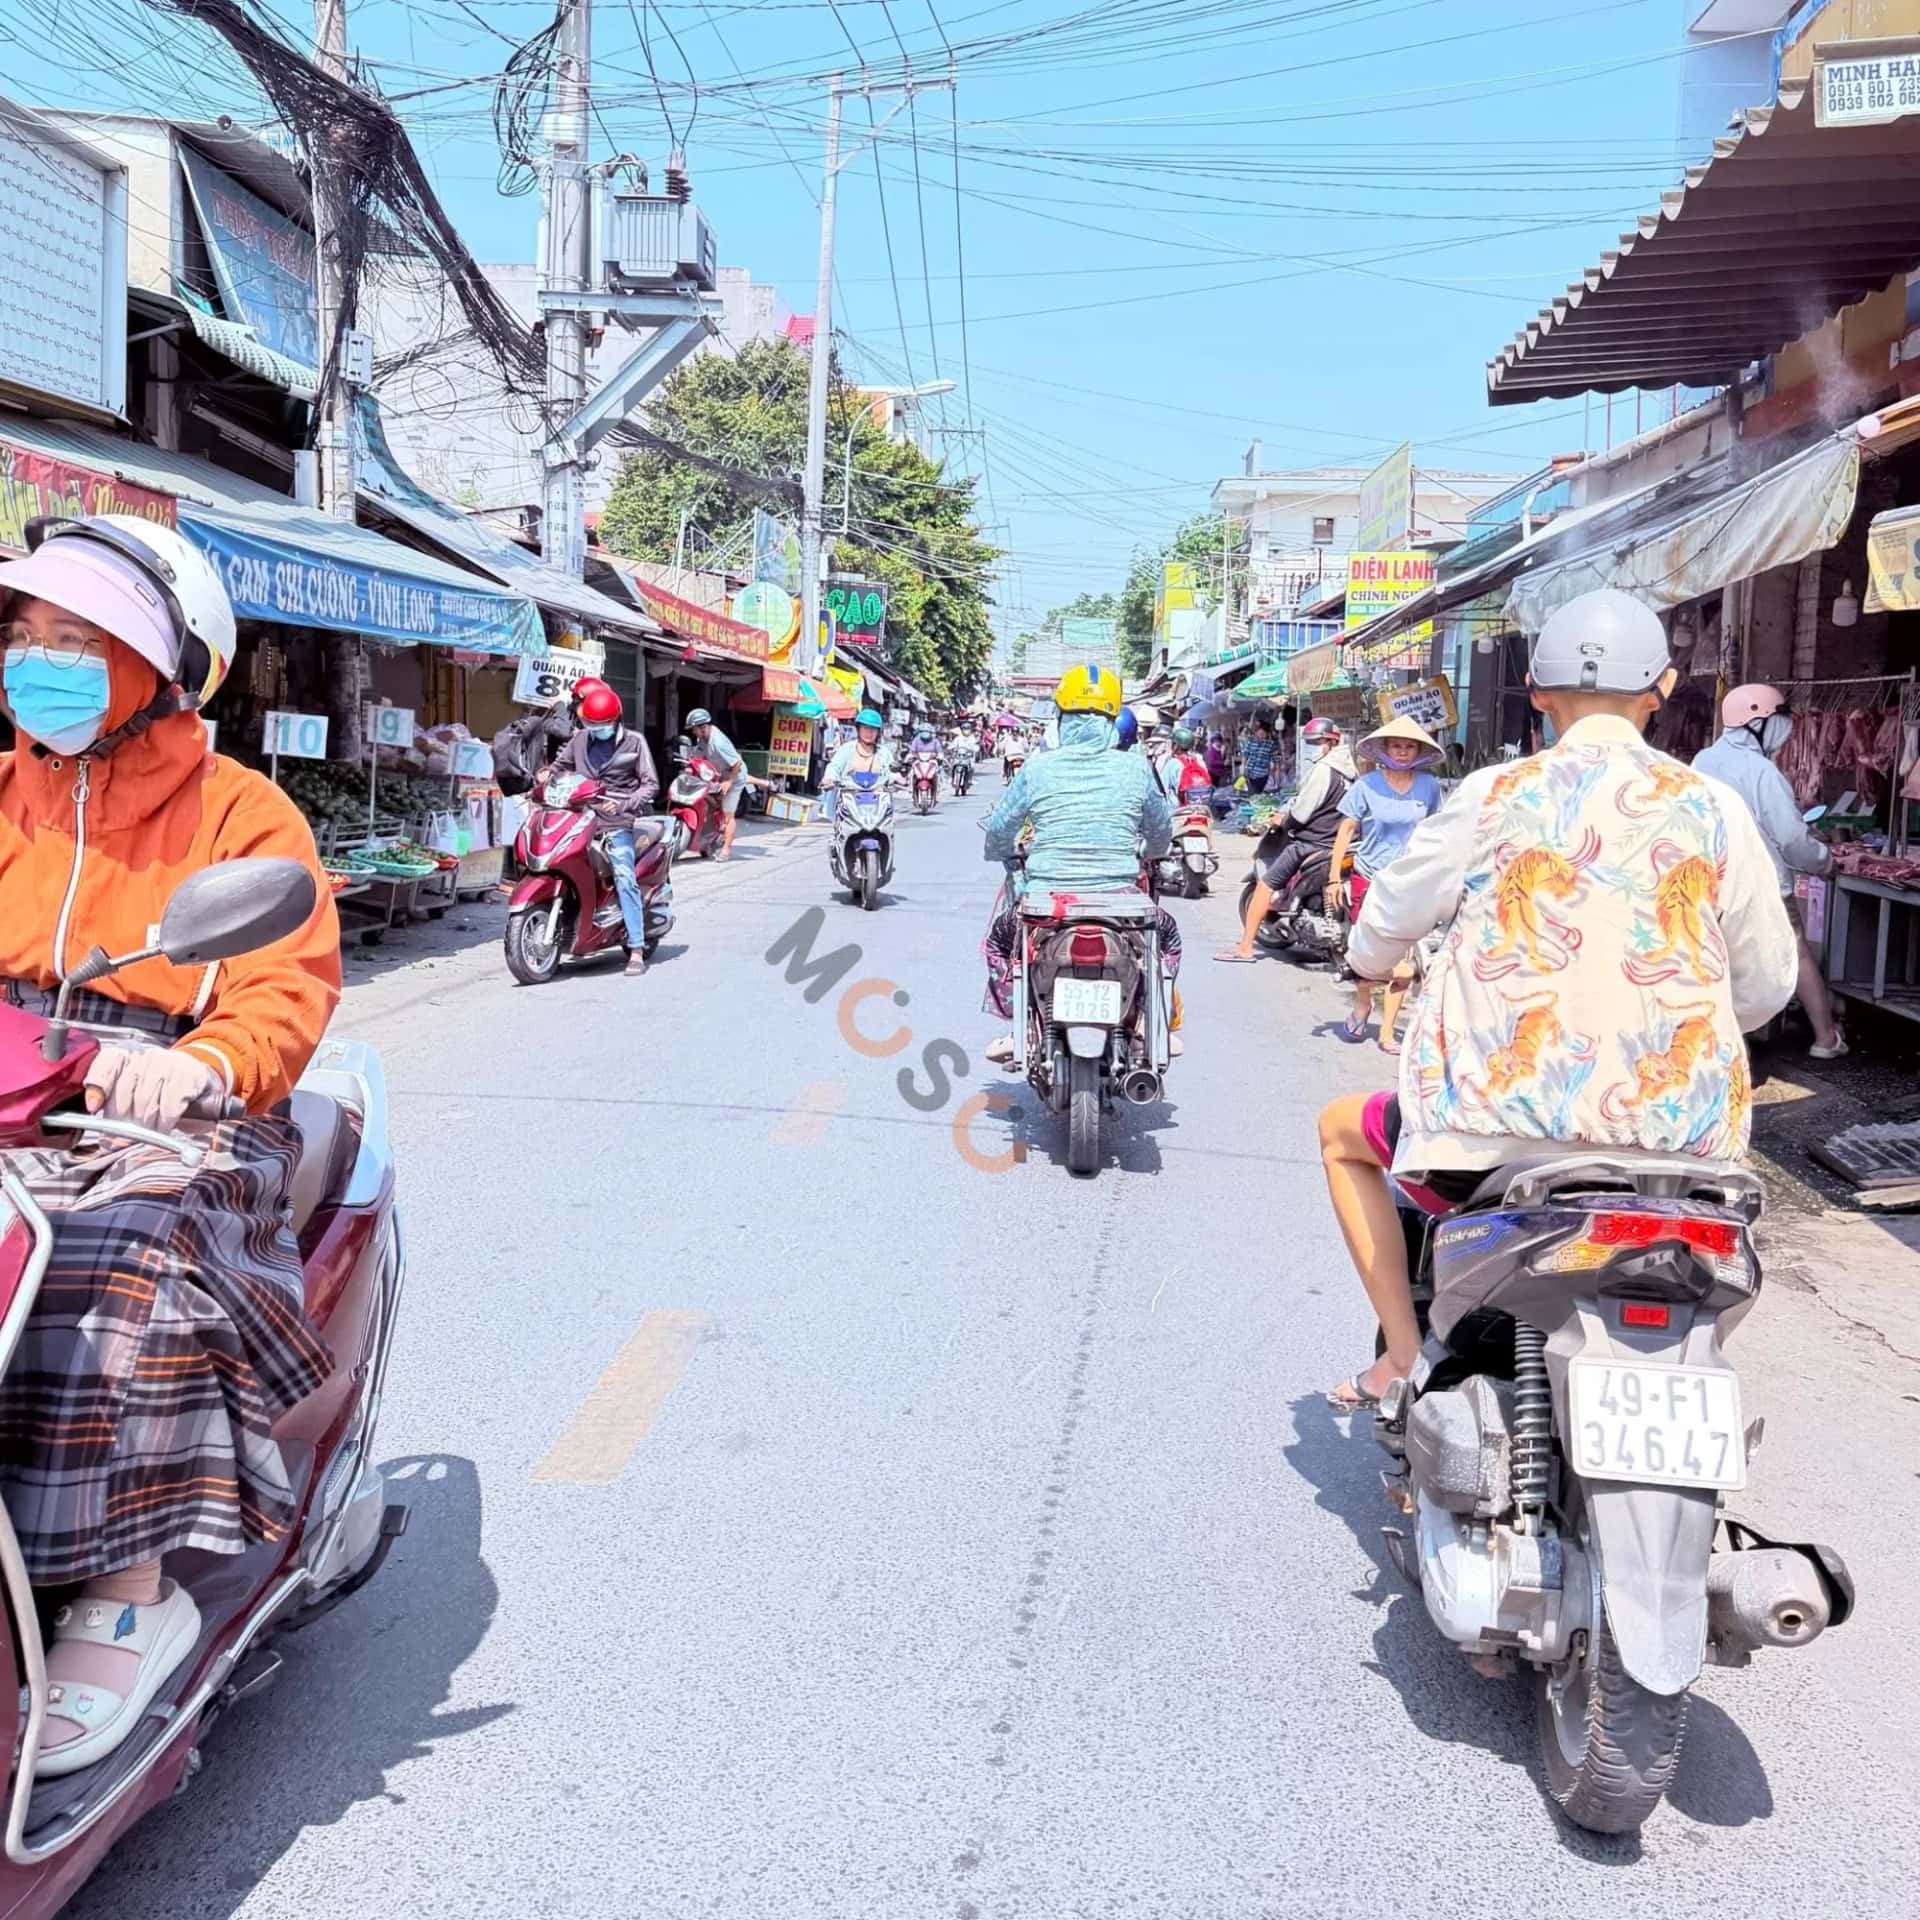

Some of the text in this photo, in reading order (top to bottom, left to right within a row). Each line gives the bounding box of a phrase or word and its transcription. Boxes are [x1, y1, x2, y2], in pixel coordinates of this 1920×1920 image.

[1827, 63, 1882, 83] MINH
[1828, 82, 1863, 98] 0914
[1868, 80, 1892, 95] 601
[1828, 96, 1863, 112] 0939
[1868, 94, 1894, 108] 602
[227, 554, 270, 605] CAM
[403, 586, 435, 634] LONG
[826, 587, 882, 633] GẠO
[279, 716, 322, 755] 10
[381, 710, 400, 743] 9
[462, 746, 481, 772] 7
[1599, 1369, 1709, 1423] 49-F1
[1583, 1420, 1729, 1478] 346.47
